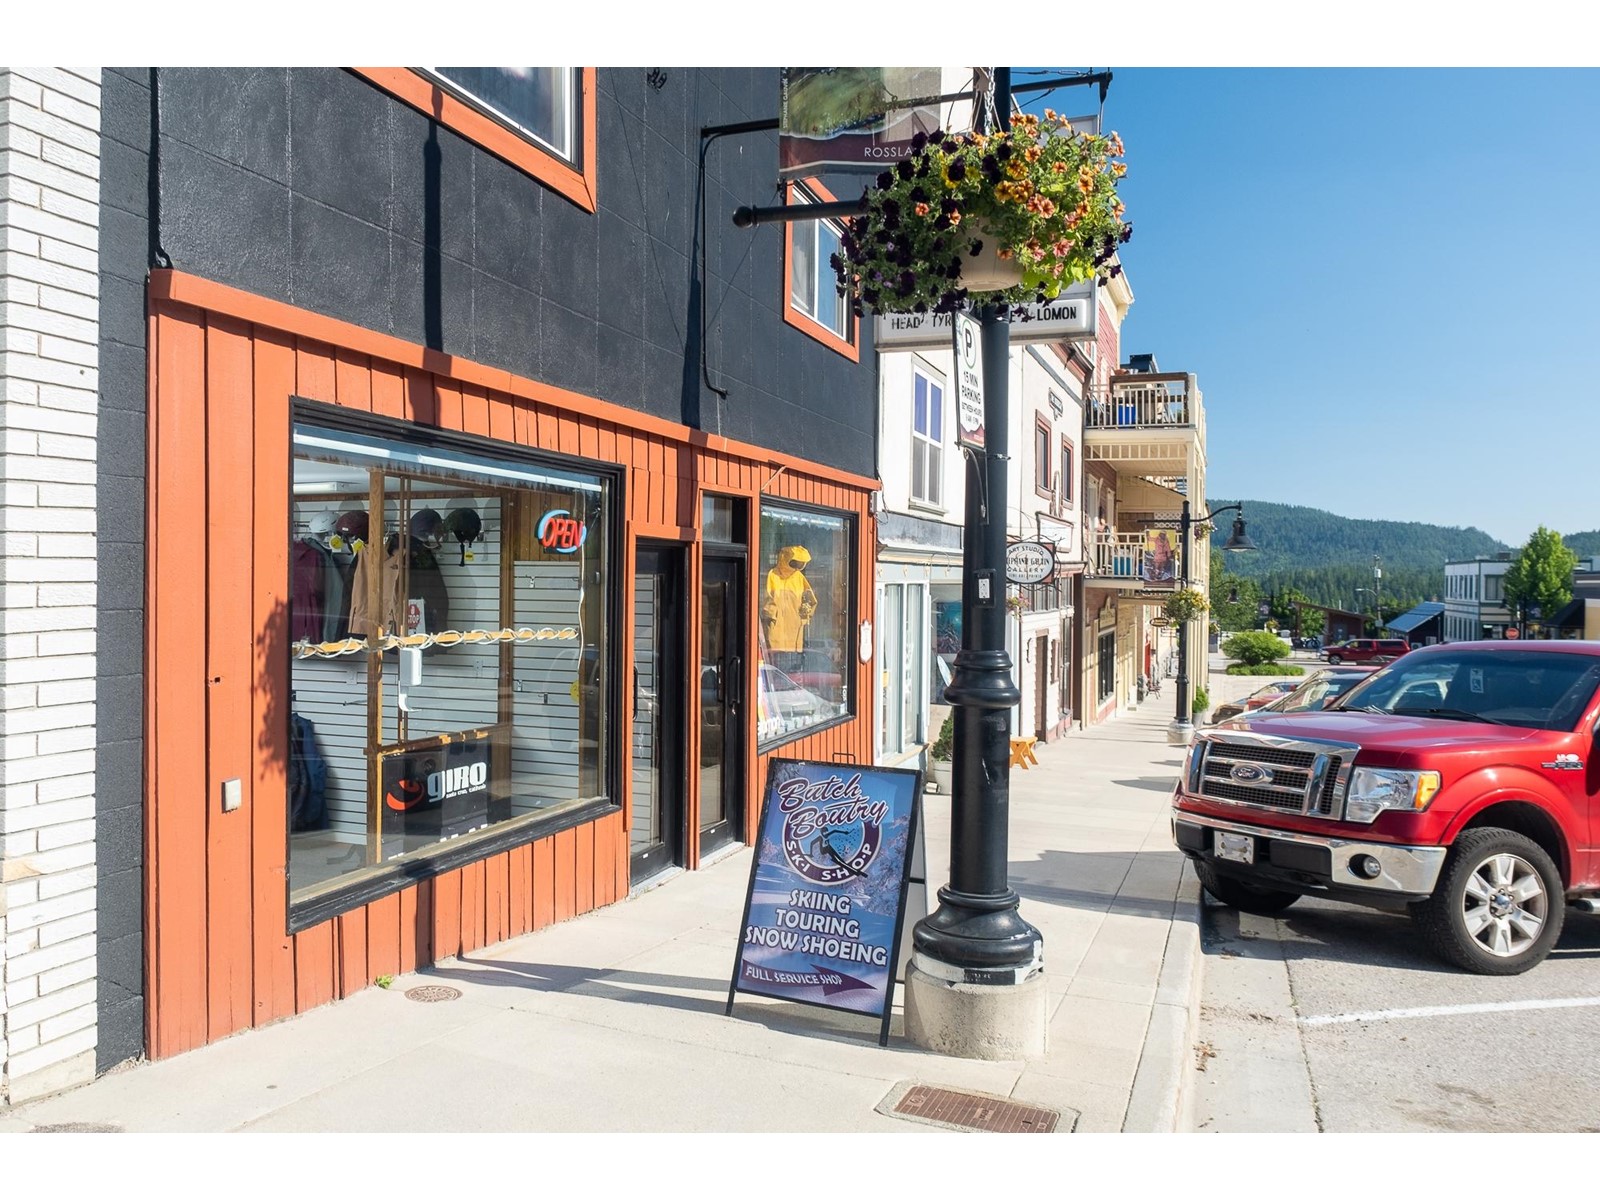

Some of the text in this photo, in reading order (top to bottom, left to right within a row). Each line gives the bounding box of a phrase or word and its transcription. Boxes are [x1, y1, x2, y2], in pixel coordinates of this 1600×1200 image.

[891, 316, 921, 330] HEAD
[962, 385, 981, 405] PARKING
[542, 517, 584, 548] OPEN
[1022, 545, 1045, 556] STUDIO
[778, 772, 862, 814] Butch
[788, 795, 890, 840] Boutry
[789, 889, 852, 916] SKIING
[775, 908, 860, 940] TOURING
[745, 925, 888, 967] SNOW SHOEING
[745, 966, 844, 986] FULL SERVICE SHOP
